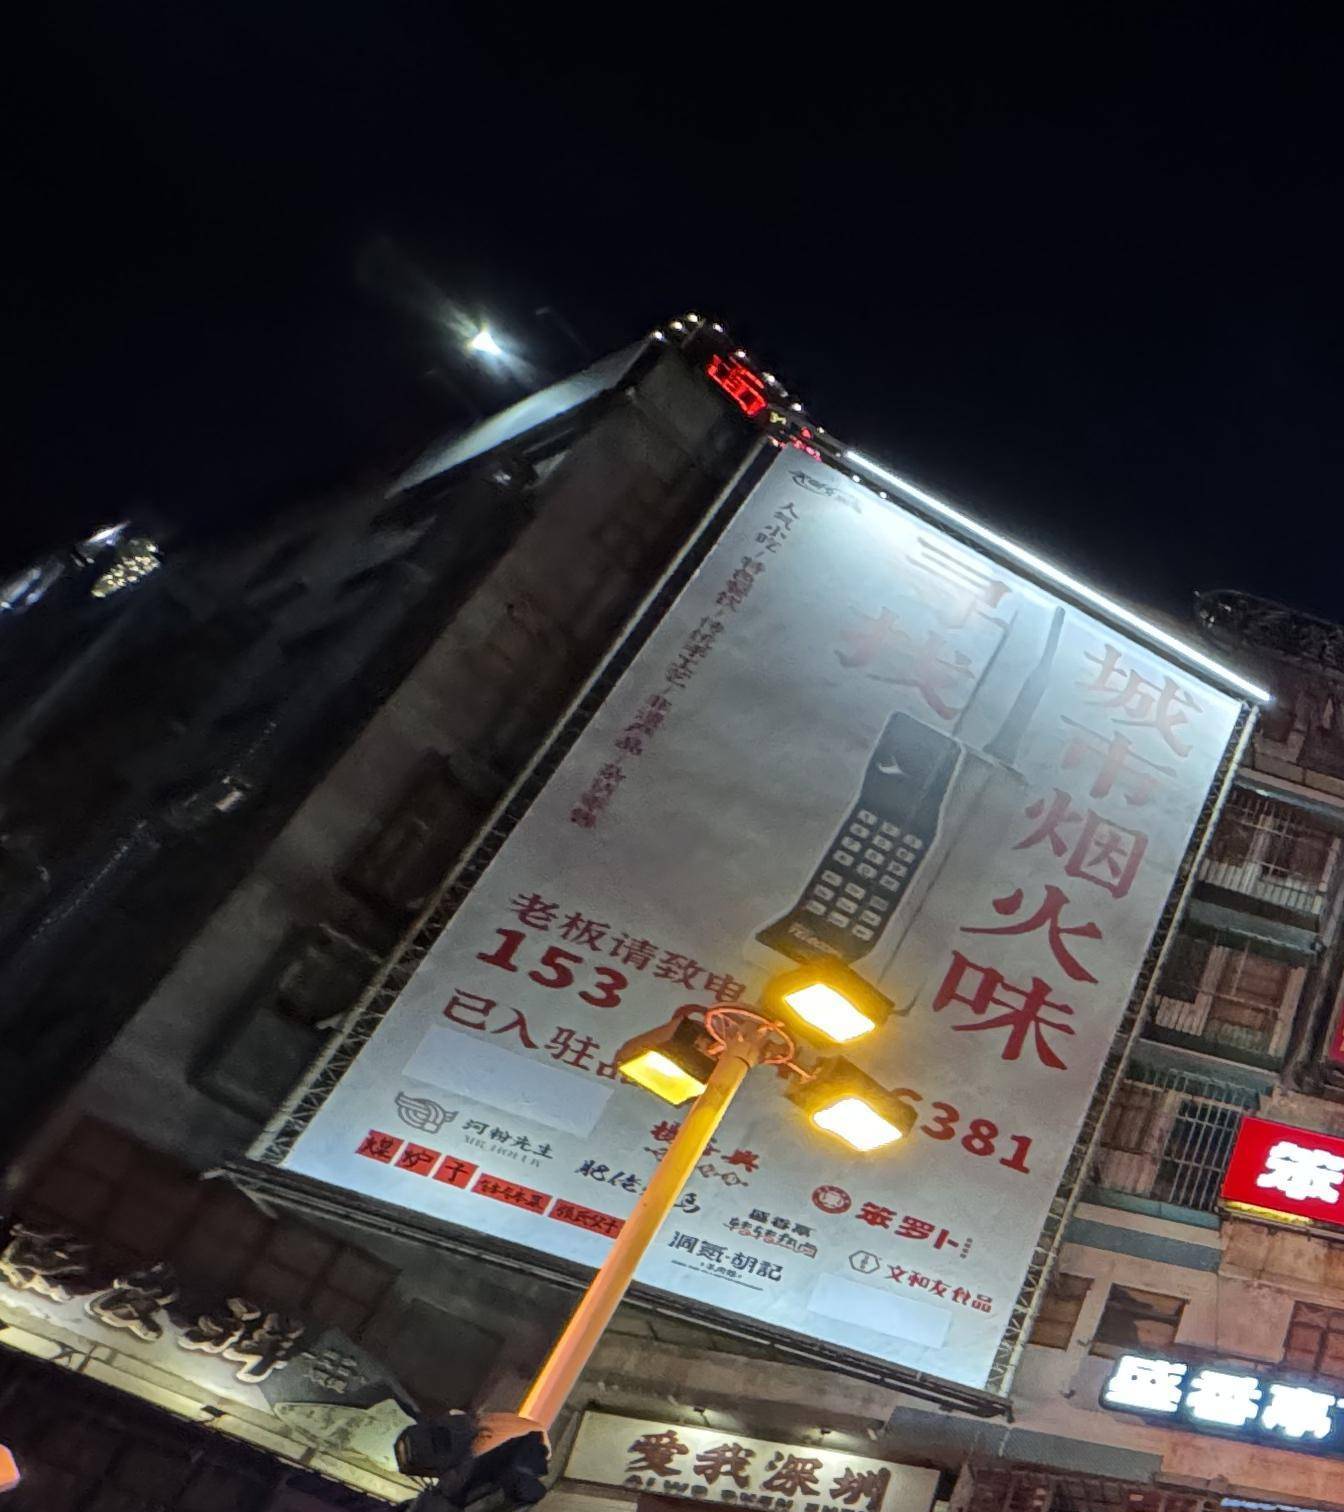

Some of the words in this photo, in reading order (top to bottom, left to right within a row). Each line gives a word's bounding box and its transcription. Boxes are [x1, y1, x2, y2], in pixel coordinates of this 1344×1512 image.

[933, 643, 1203, 1071] 城市烟火味
[477, 926, 629, 1009] 153
[511, 892, 747, 1003] 老板请致电
[441, 988, 630, 1085] 已入驻
[463, 1118, 553, 1160] 河粉先生
[855, 1201, 959, 1250] 笨罗卜
[884, 1263, 993, 1313] 文和友食品
